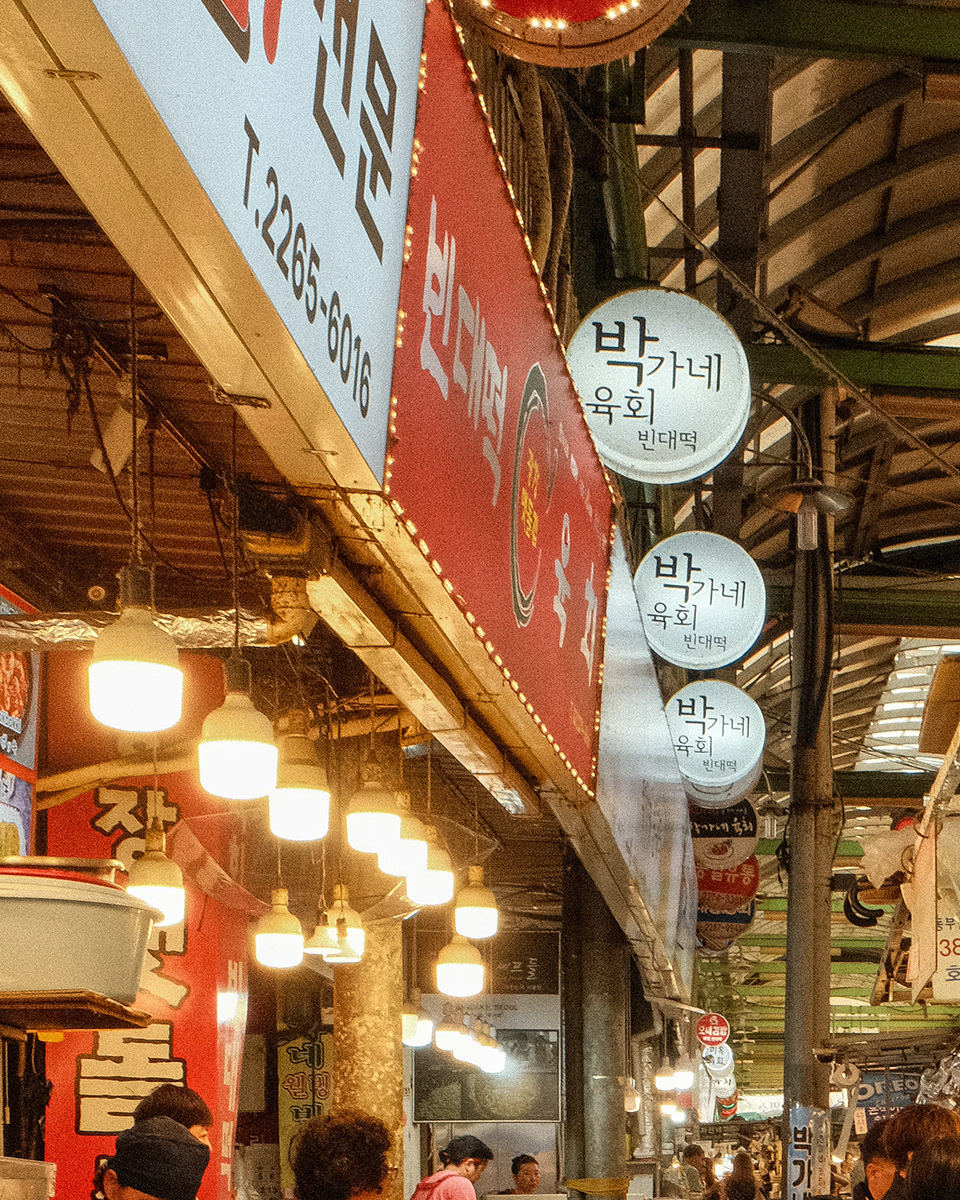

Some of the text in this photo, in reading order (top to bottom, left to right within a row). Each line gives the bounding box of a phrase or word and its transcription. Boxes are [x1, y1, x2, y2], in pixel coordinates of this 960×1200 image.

[243, 115, 374, 419] T.2265-6016
[420, 195, 509, 507] 빈대떡
[591, 315, 722, 392] 박가네
[585, 386, 655, 426] 육회
[637, 428, 698, 453] 빈대떡
[653, 552, 747, 609] 박가네
[646, 601, 698, 631] 육회
[683, 633, 728, 651] 빈대떡
[676, 695, 751, 739] 박가네
[673, 735, 714, 757] 육회
[702, 759, 738, 773] 빈대떡
[731, 816, 754, 836] 육회
[283, 1071, 331, 1100] 웰빙
